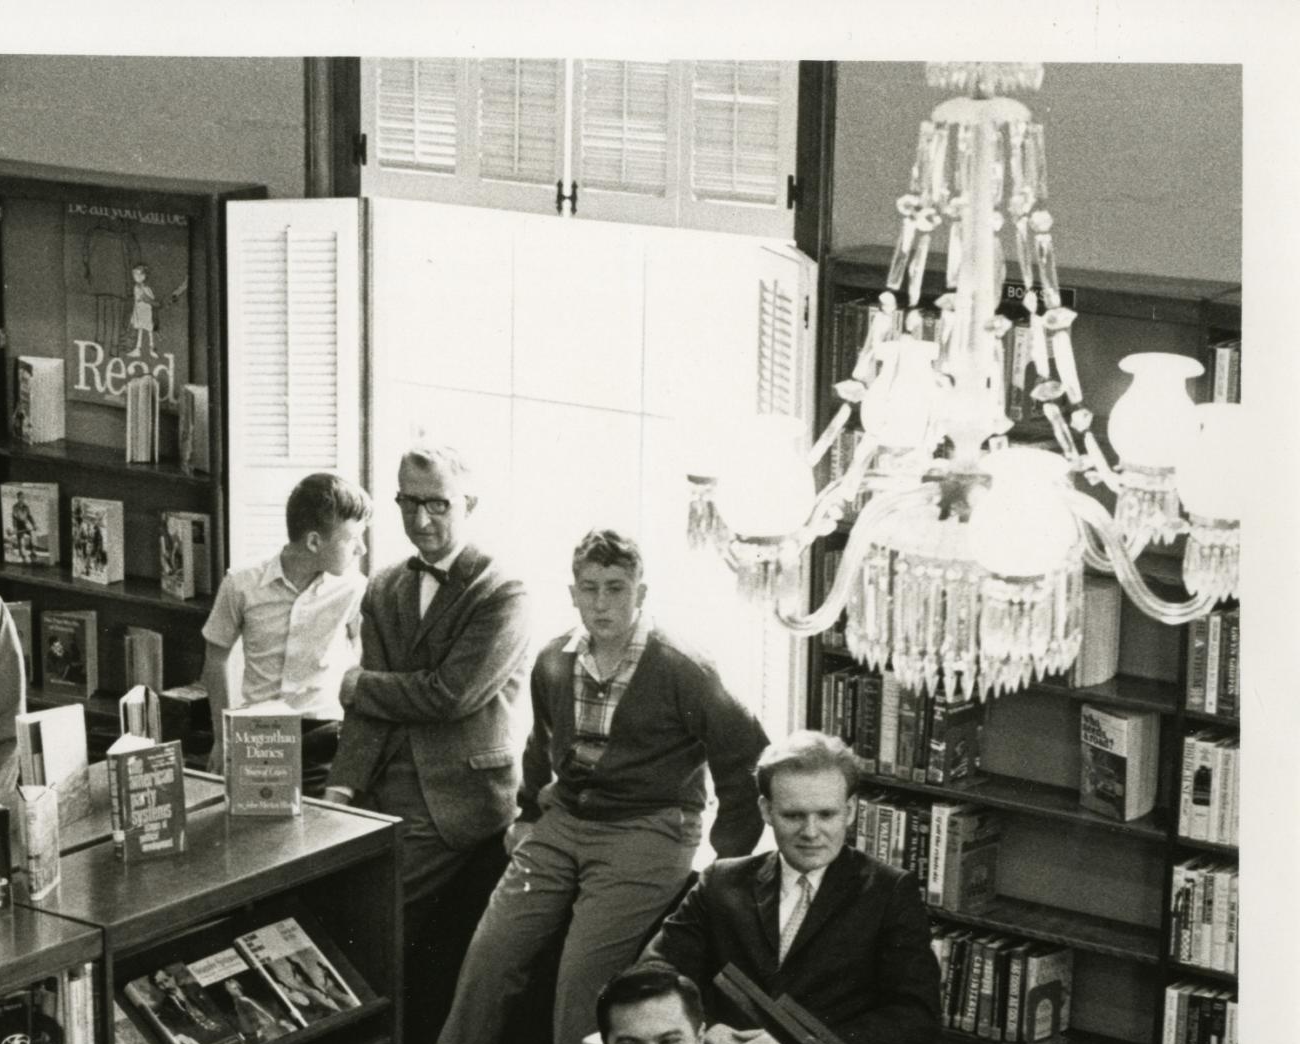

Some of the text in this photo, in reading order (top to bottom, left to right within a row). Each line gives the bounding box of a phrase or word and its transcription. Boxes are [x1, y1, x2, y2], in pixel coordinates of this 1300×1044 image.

[1007, 286, 1046, 301] BOS
[235, 729, 296, 748] Morgenthau
[246, 746, 285, 759] Diaries
